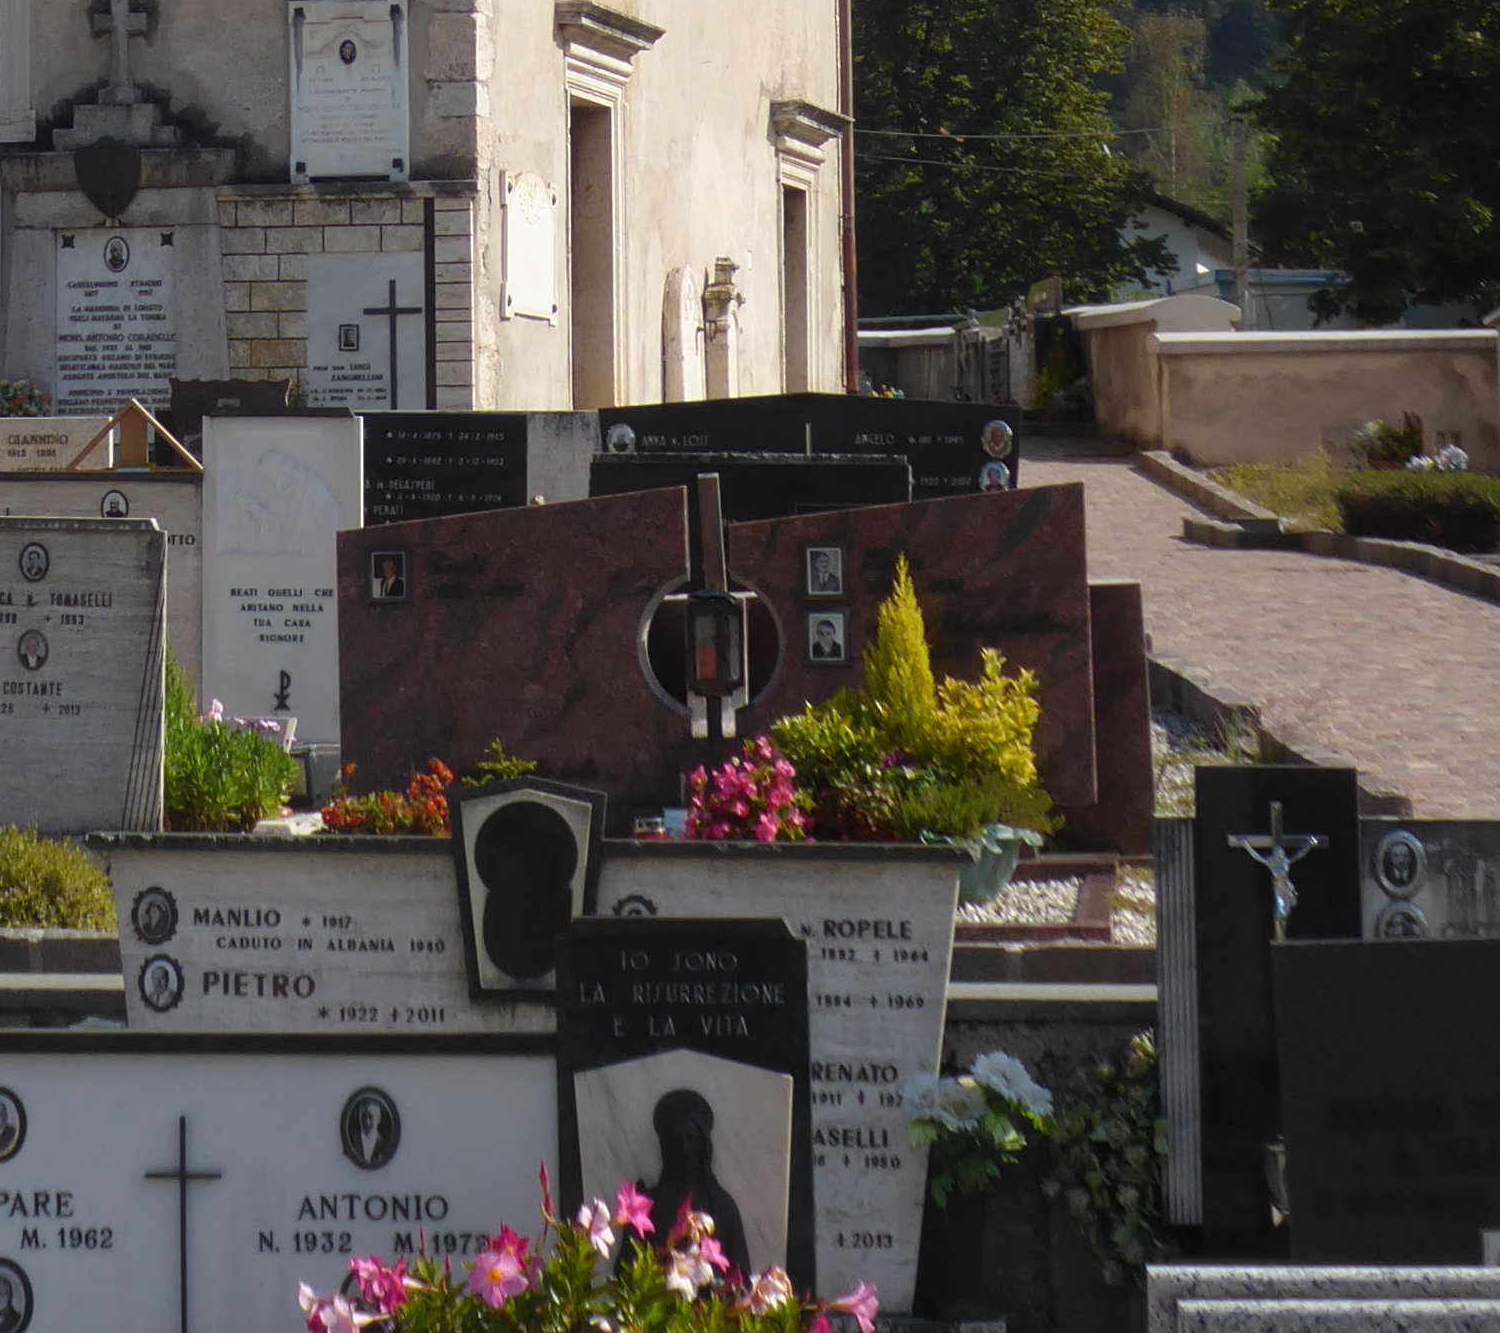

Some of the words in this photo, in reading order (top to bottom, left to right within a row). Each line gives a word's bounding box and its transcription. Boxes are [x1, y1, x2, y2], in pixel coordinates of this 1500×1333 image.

[7, 433, 69, 445] GIANNINO
[641, 433, 667, 446] ANNA
[853, 433, 896, 445] ANGELO
[50, 592, 113, 608] TOMASELLI
[230, 588, 258, 597] BEATI
[267, 587, 303, 598] QUELLI
[240, 603, 284, 613] ABITANO
[292, 603, 324, 613] NELLA
[253, 618, 273, 628] TUA
[283, 618, 311, 628] CASA
[259, 633, 304, 643] SIGNORE
[3, 680, 63, 697] COSTANTE
[193, 907, 282, 928] MANLIO
[322, 915, 353, 929] 1917
[823, 918, 913, 941] ROPELE
[216, 936, 283, 951] CADUTO
[297, 936, 313, 951] IN
[325, 938, 396, 953] ALBANIA
[409, 938, 446, 954] 1940
[620, 949, 649, 971] IO
[673, 949, 739, 973] SONO
[202, 970, 316, 999] PIETRO
[579, 980, 606, 1005] LA
[631, 981, 786, 1006] RISURREZIONE
[339, 1005, 379, 1023] 1922
[406, 1006, 446, 1023] 2011
[613, 1014, 626, 1037] E
[647, 1014, 677, 1038] LA
[700, 1010, 750, 1037] VITA
[811, 1062, 899, 1083] RENATO
[297, 1192, 450, 1221] ANTONIO
[20, 1225, 48, 1250] M.
[57, 1226, 114, 1250] 1962
[258, 1230, 281, 1253] N.
[293, 1230, 353, 1254] 1932
[851, 1232, 893, 1249] 2013
